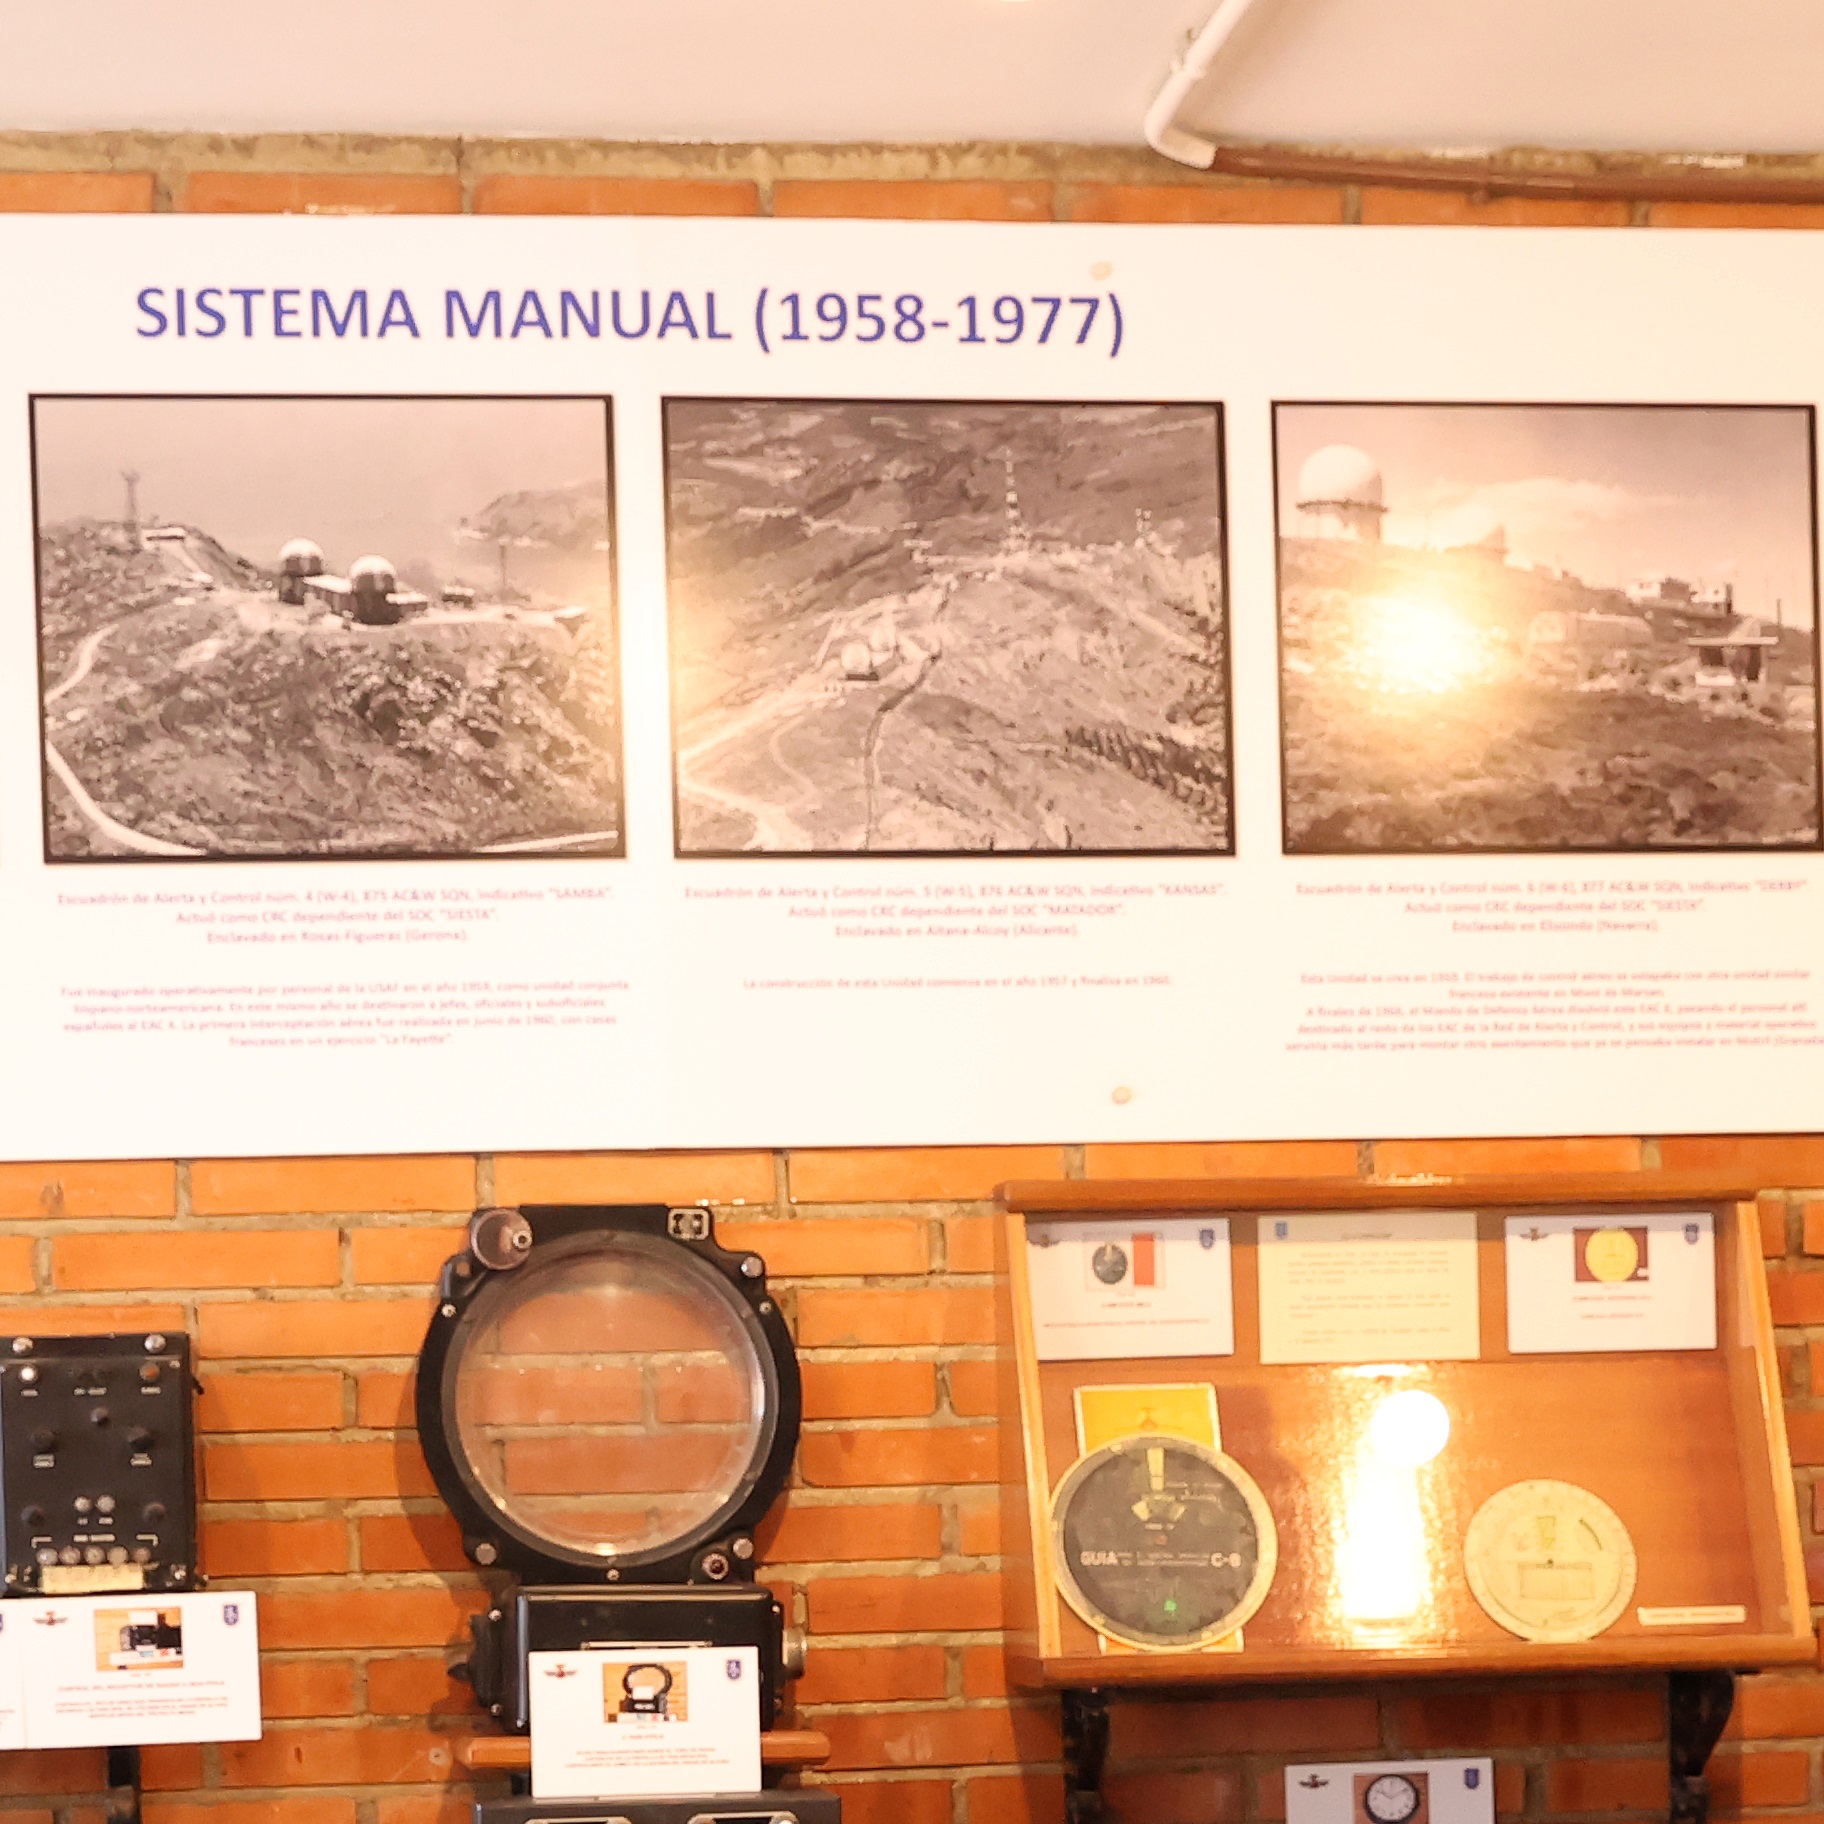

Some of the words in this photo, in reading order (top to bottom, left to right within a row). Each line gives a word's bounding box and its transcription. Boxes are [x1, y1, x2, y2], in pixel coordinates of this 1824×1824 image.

[136, 287, 421, 338] SISTEMA
[444, 288, 733, 340] MANUAL
[754, 288, 1125, 357] (1958-1977)
[131, 891, 151, 905] de
[219, 911, 259, 924] como
[381, 908, 405, 921] del
[279, 932, 299, 943] en
